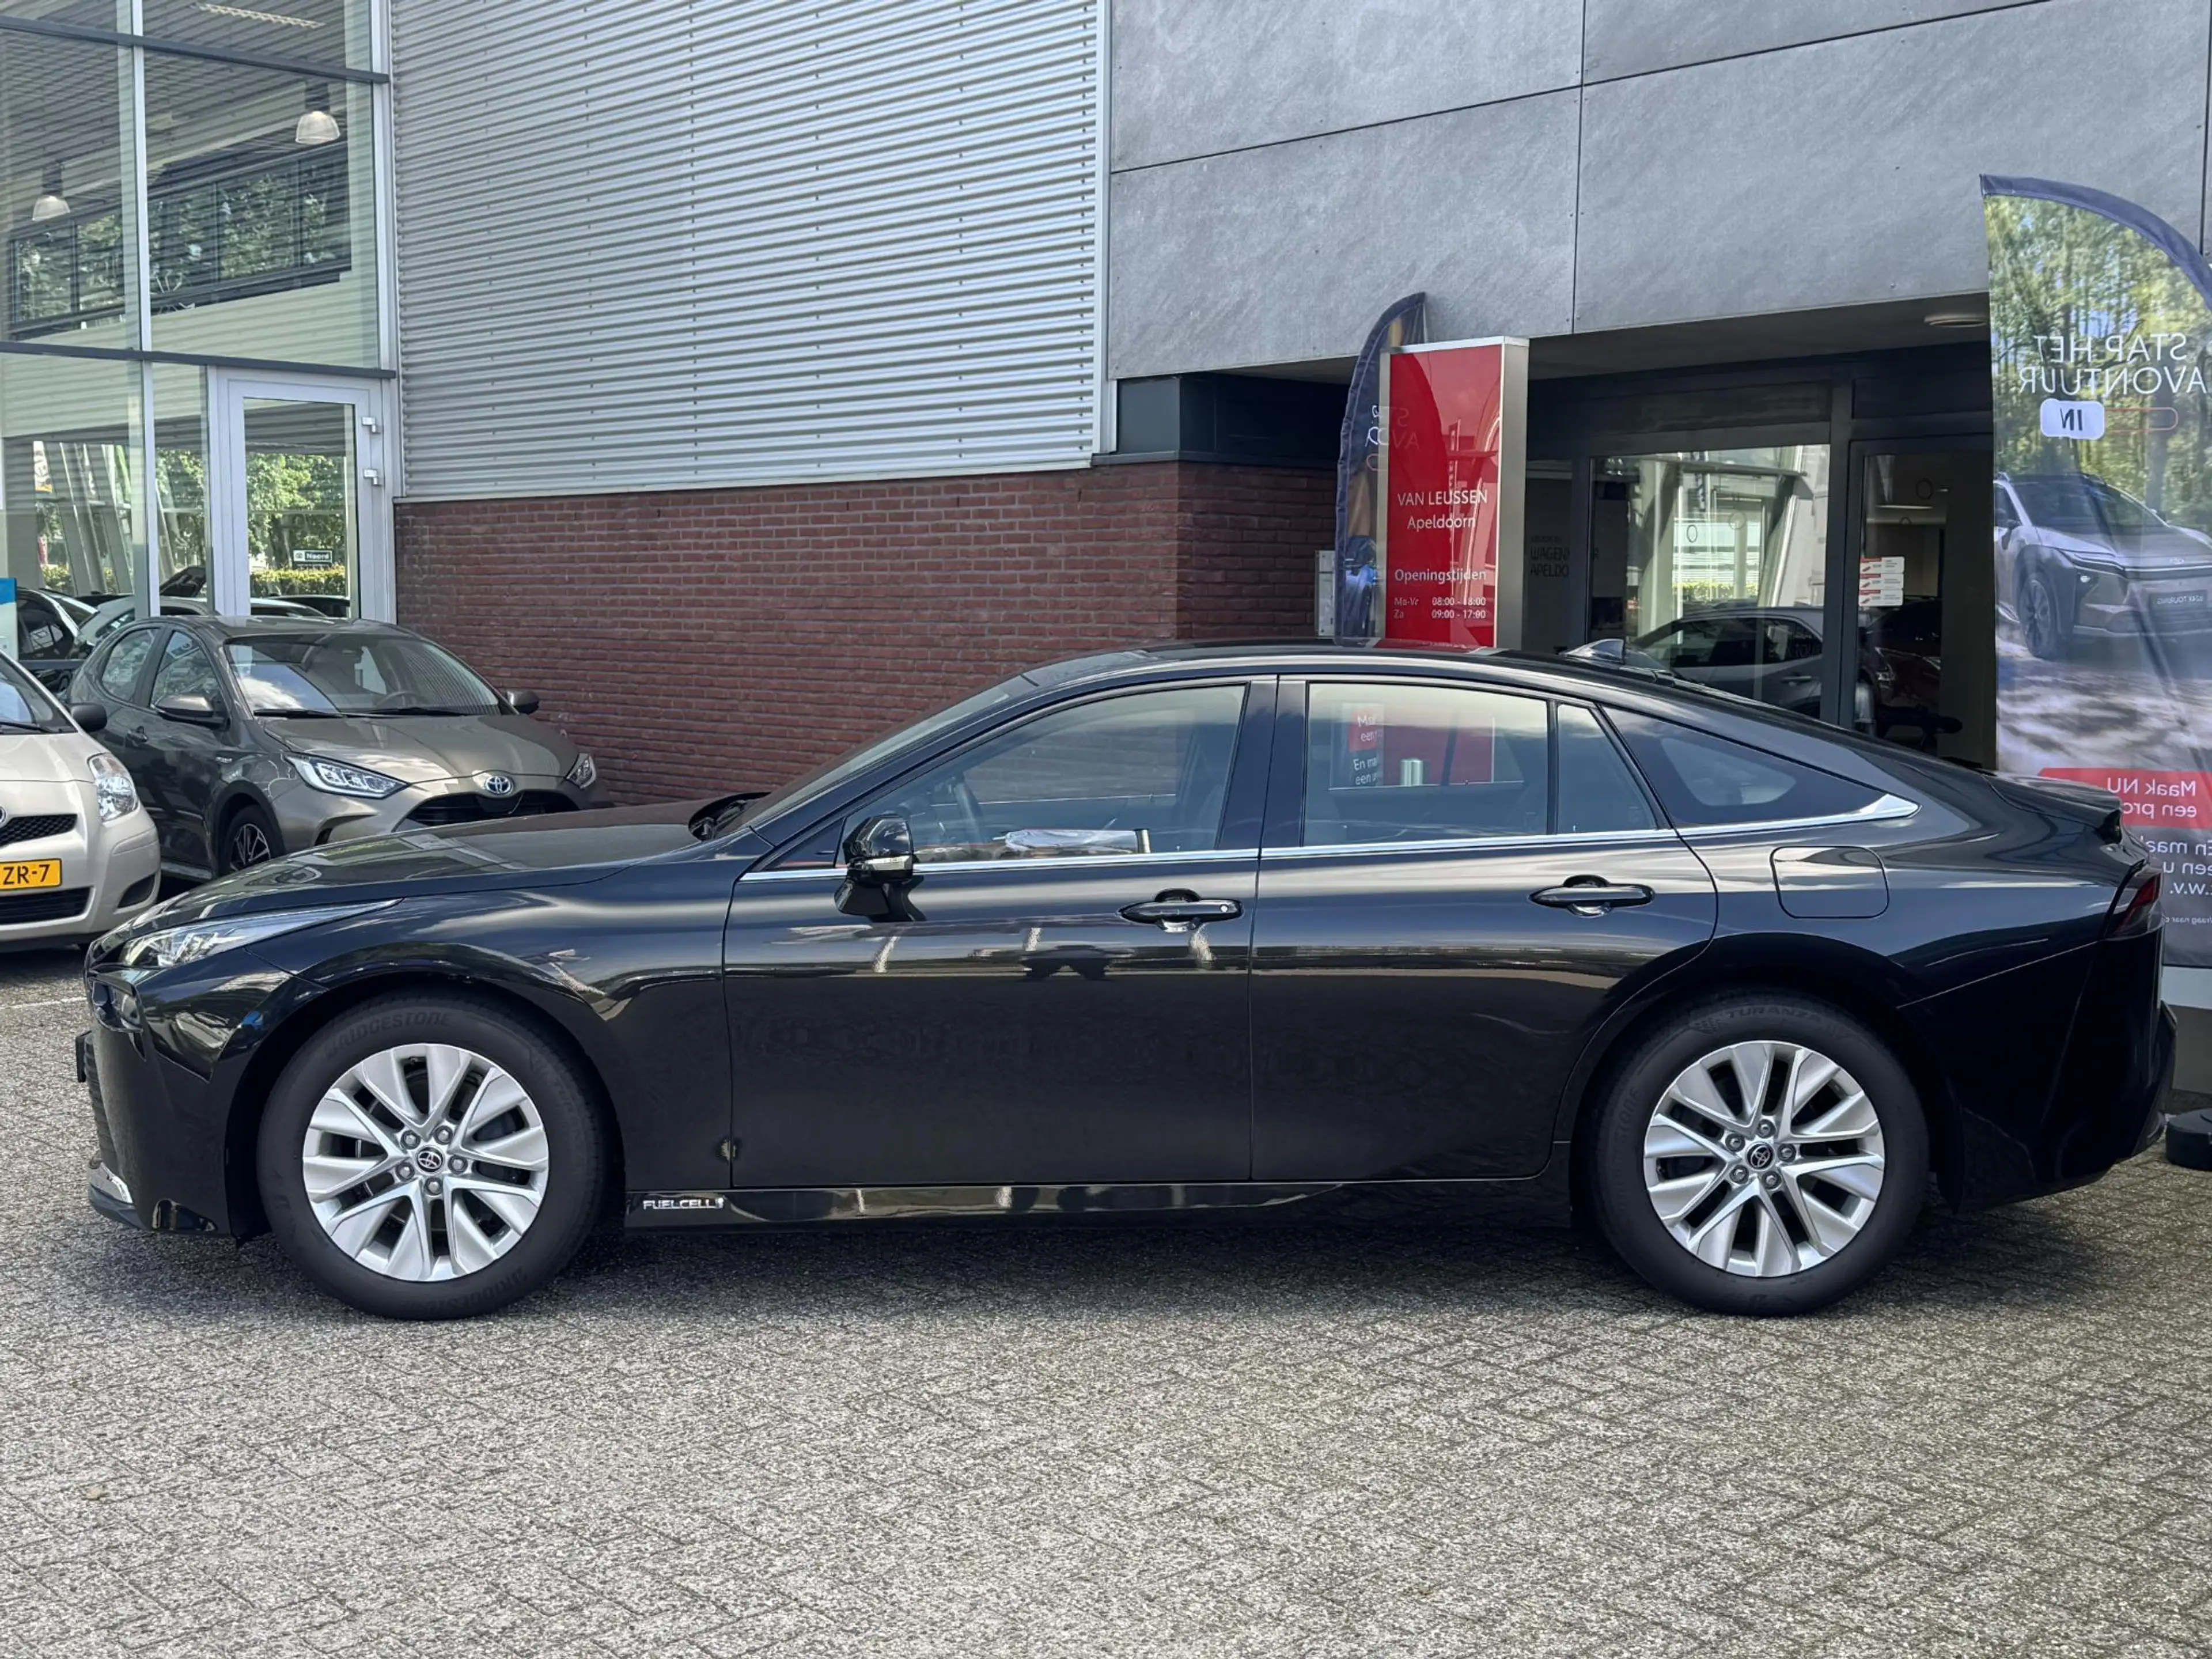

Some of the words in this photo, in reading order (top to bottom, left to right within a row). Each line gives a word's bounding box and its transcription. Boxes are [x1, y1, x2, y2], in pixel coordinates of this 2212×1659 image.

[1397, 493, 1425, 506] VAN
[1429, 490, 1487, 505] LEUSSEN
[1407, 515, 1476, 532] Apeldoorn
[1395, 569, 1486, 585] Openingstijden
[1432, 597, 1455, 605] 08:00
[1431, 609, 1455, 619] 09:00
